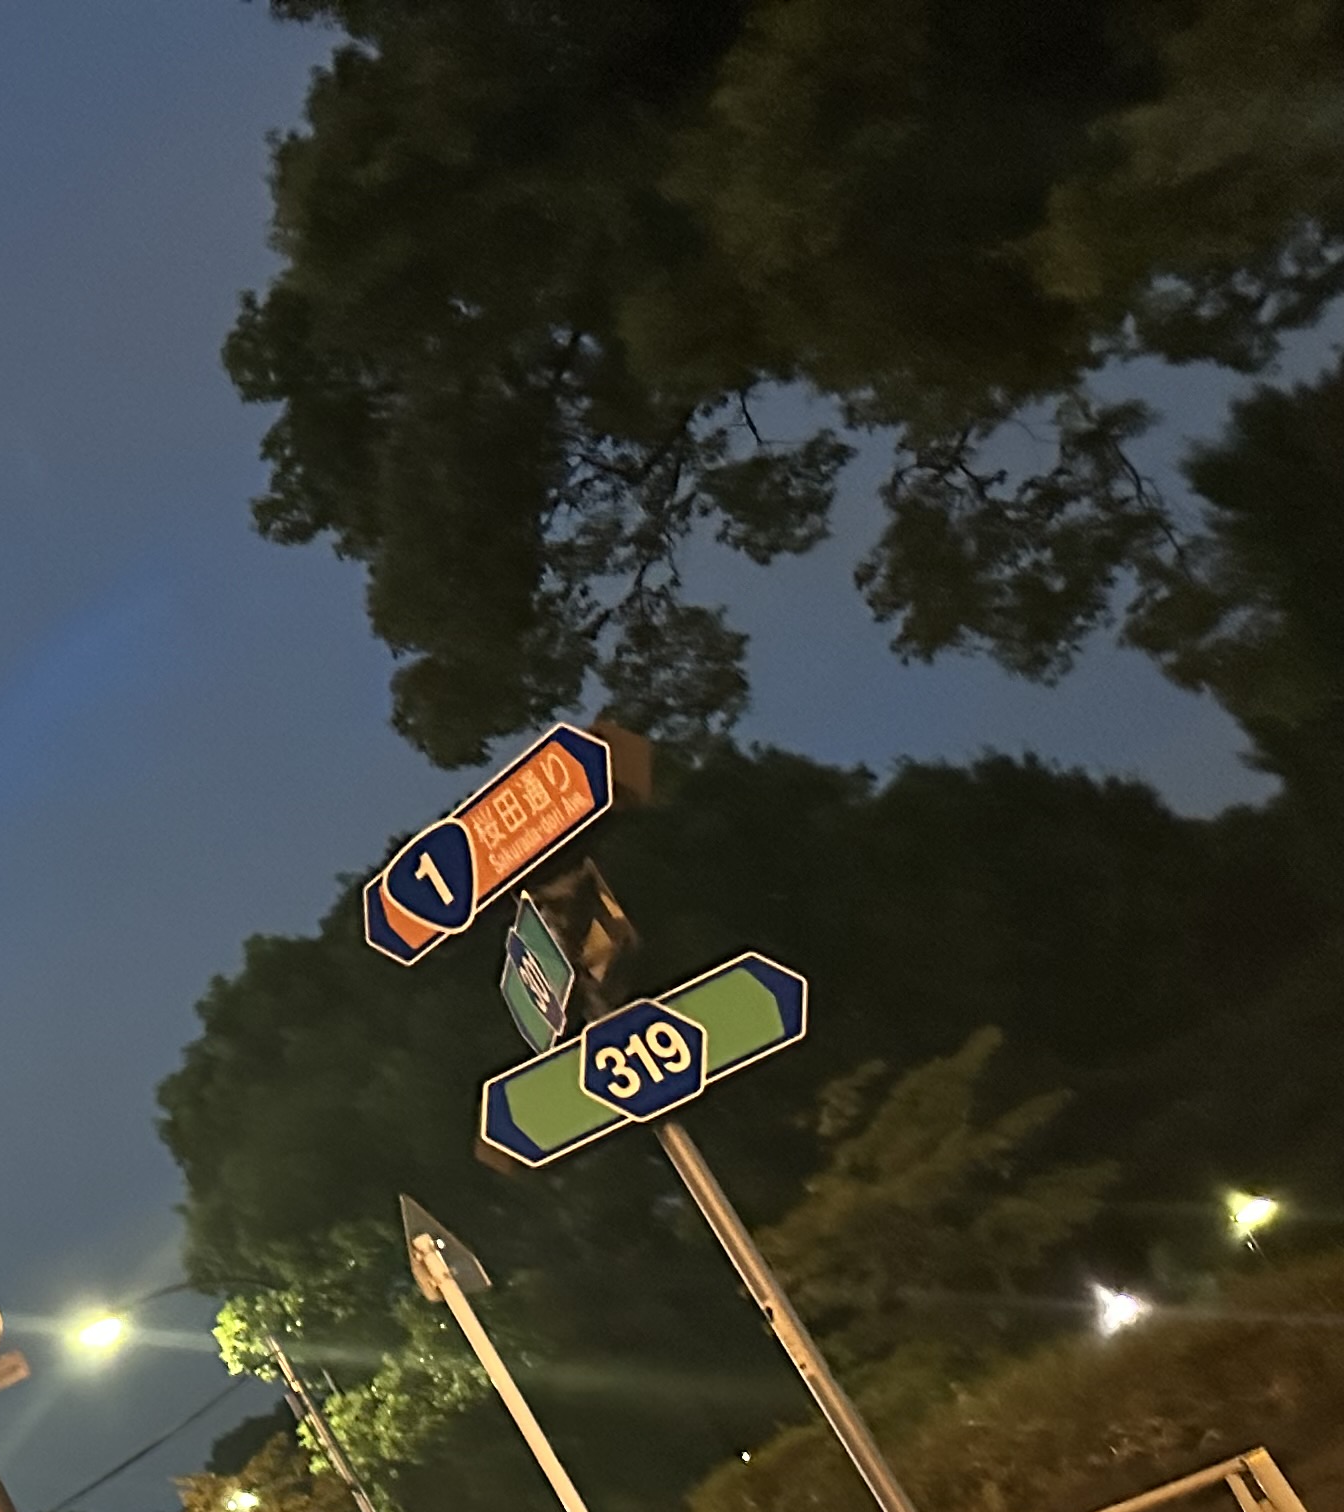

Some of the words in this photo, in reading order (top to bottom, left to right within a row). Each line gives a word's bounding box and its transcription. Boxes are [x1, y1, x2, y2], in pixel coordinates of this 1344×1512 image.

[472, 753, 570, 850] 桜田通り
[414, 852, 454, 906] 1
[594, 1021, 691, 1099] 319
